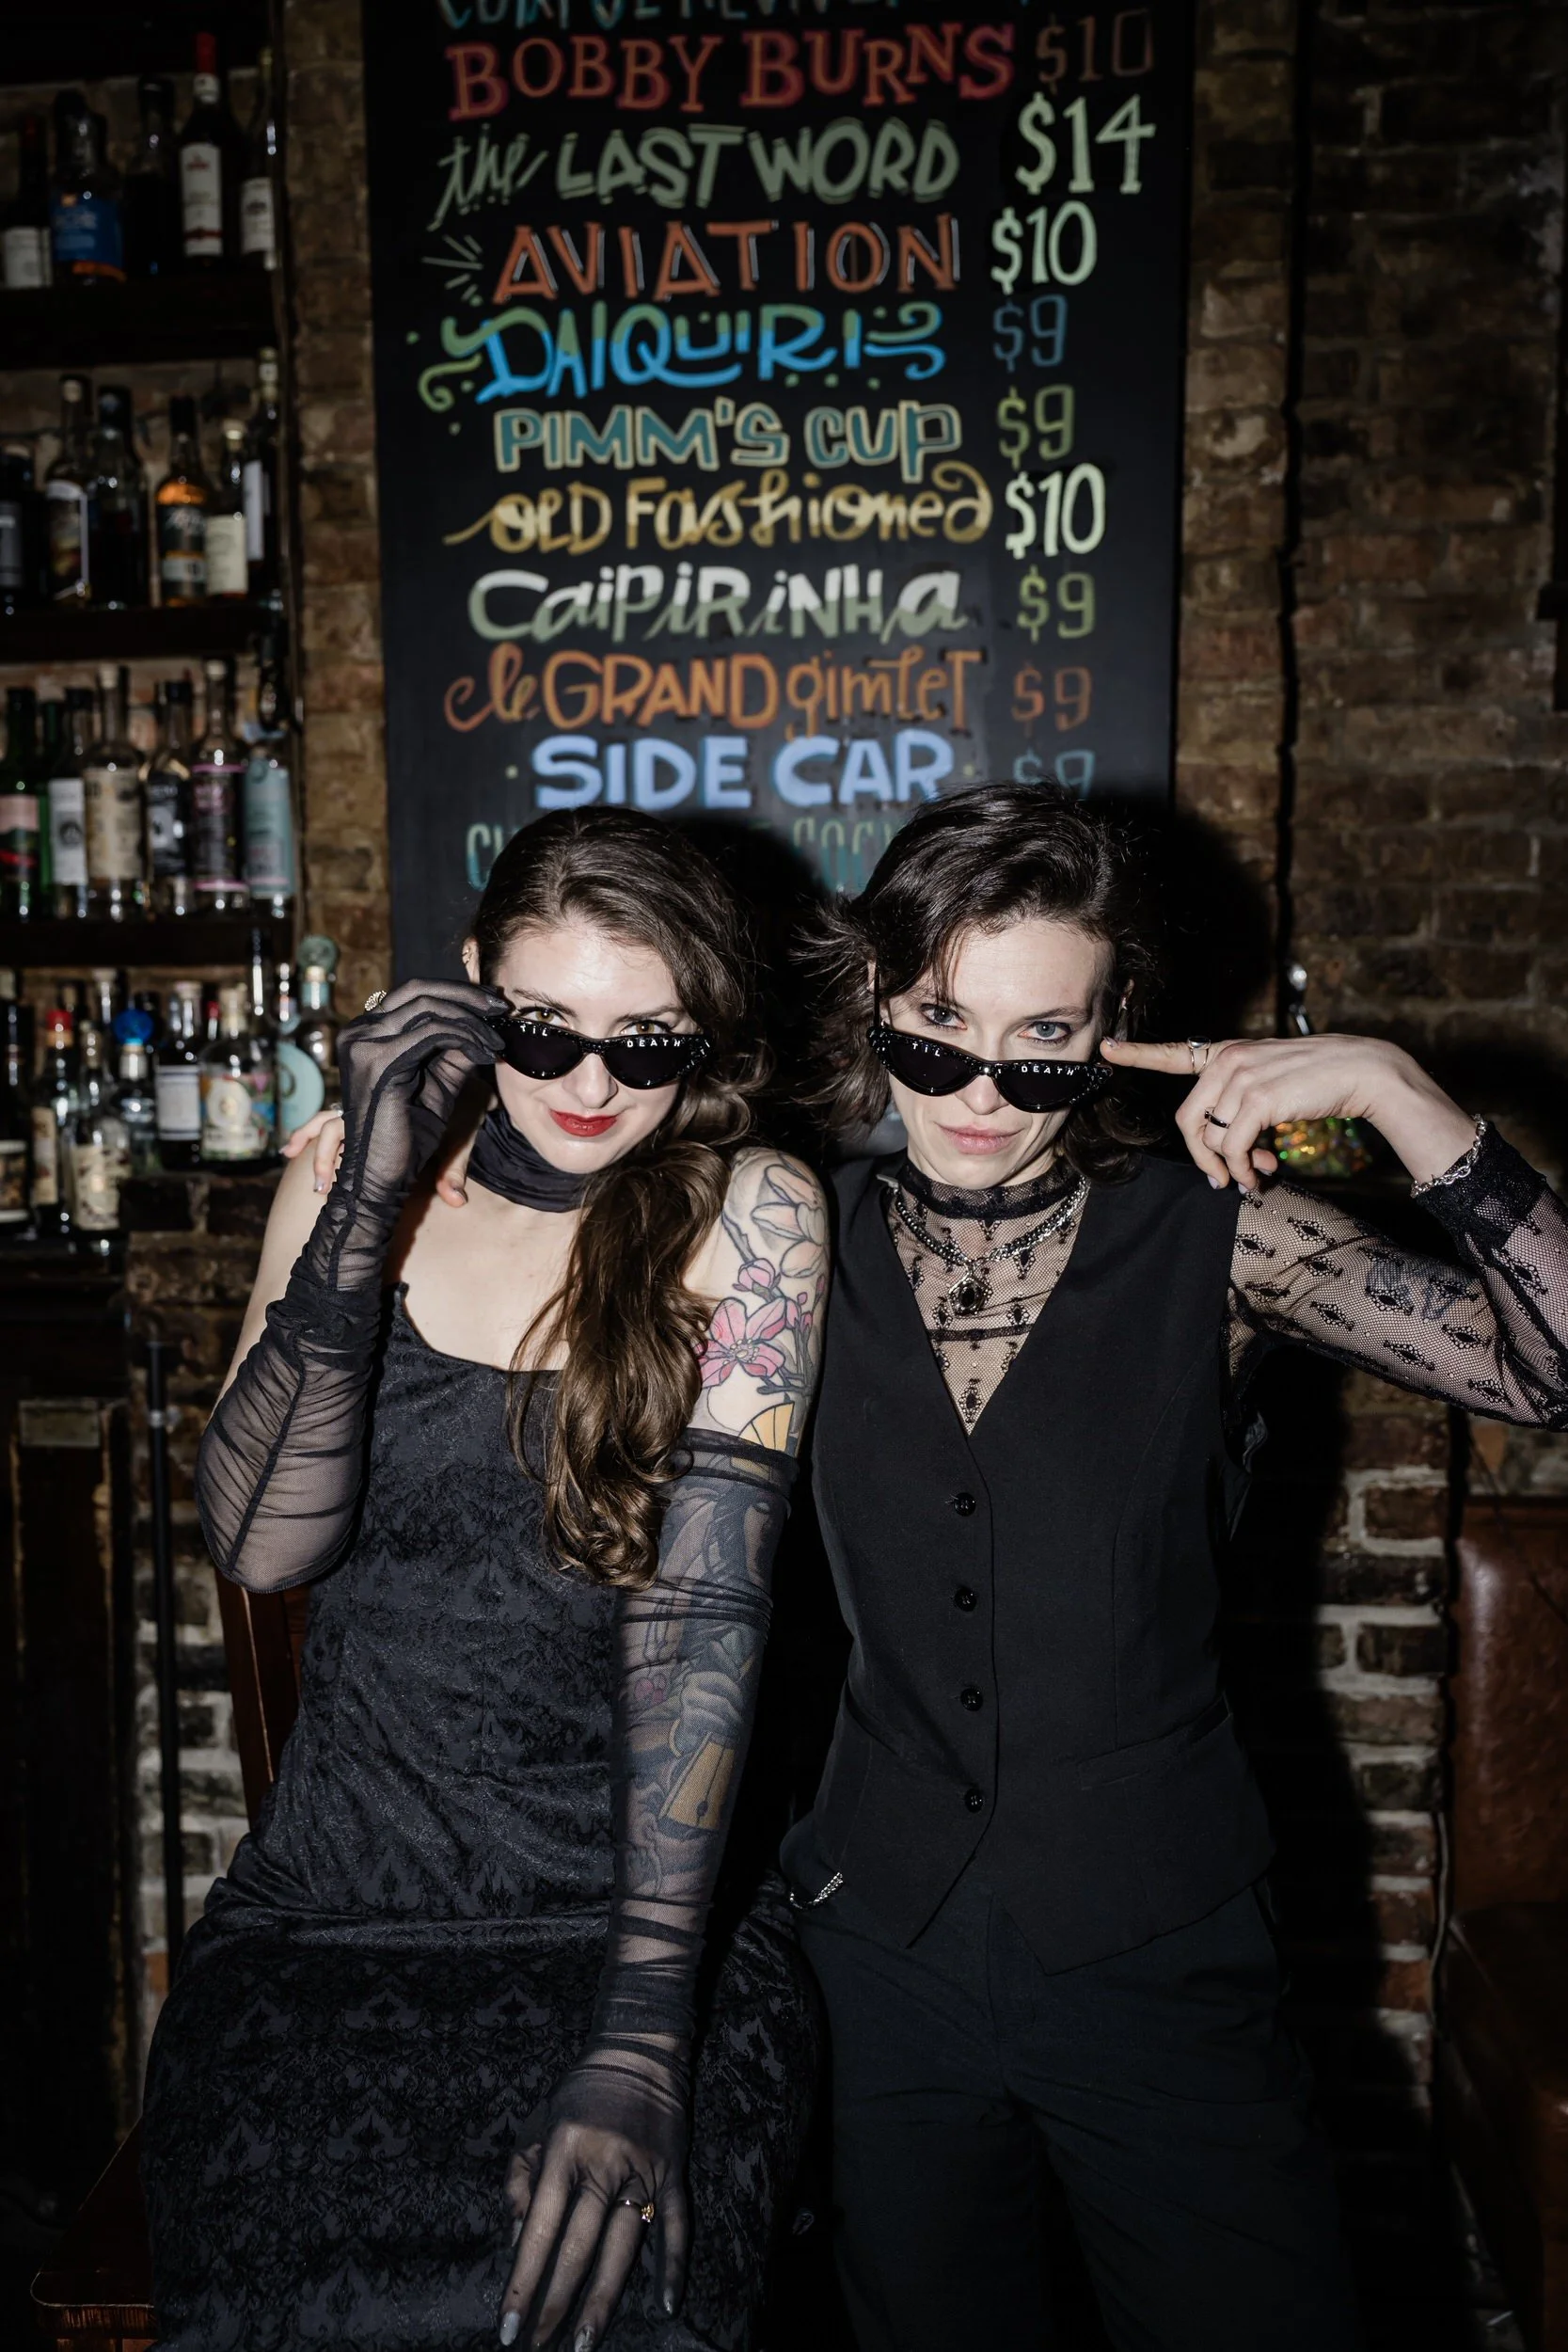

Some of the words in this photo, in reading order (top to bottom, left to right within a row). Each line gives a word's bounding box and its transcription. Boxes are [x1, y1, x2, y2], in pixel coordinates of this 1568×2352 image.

[445, 33, 722, 121] BOBBY
[738, 23, 1016, 109] BURNS
[1037, 10, 1155, 95] $10
[555, 122, 747, 209] LAST
[748, 117, 960, 204] WORD
[1014, 91, 1157, 196] $14
[491, 213, 961, 306] AVIATION
[990, 199, 1099, 296] $10
[992, 293, 1069, 373] $9
[493, 396, 791, 473] PIMM'S
[996, 383, 1075, 470] $9
[1005, 462, 1107, 561] $10
[1016, 564, 1097, 644] $9
[541, 648, 779, 731] GRAND
[1011, 661, 1093, 739] $9
[531, 734, 752, 810] SIDE
[773, 728, 955, 809] CAR
[626, 1038, 681, 1048] DEATH
[1021, 1064, 1075, 1077] DEATH
